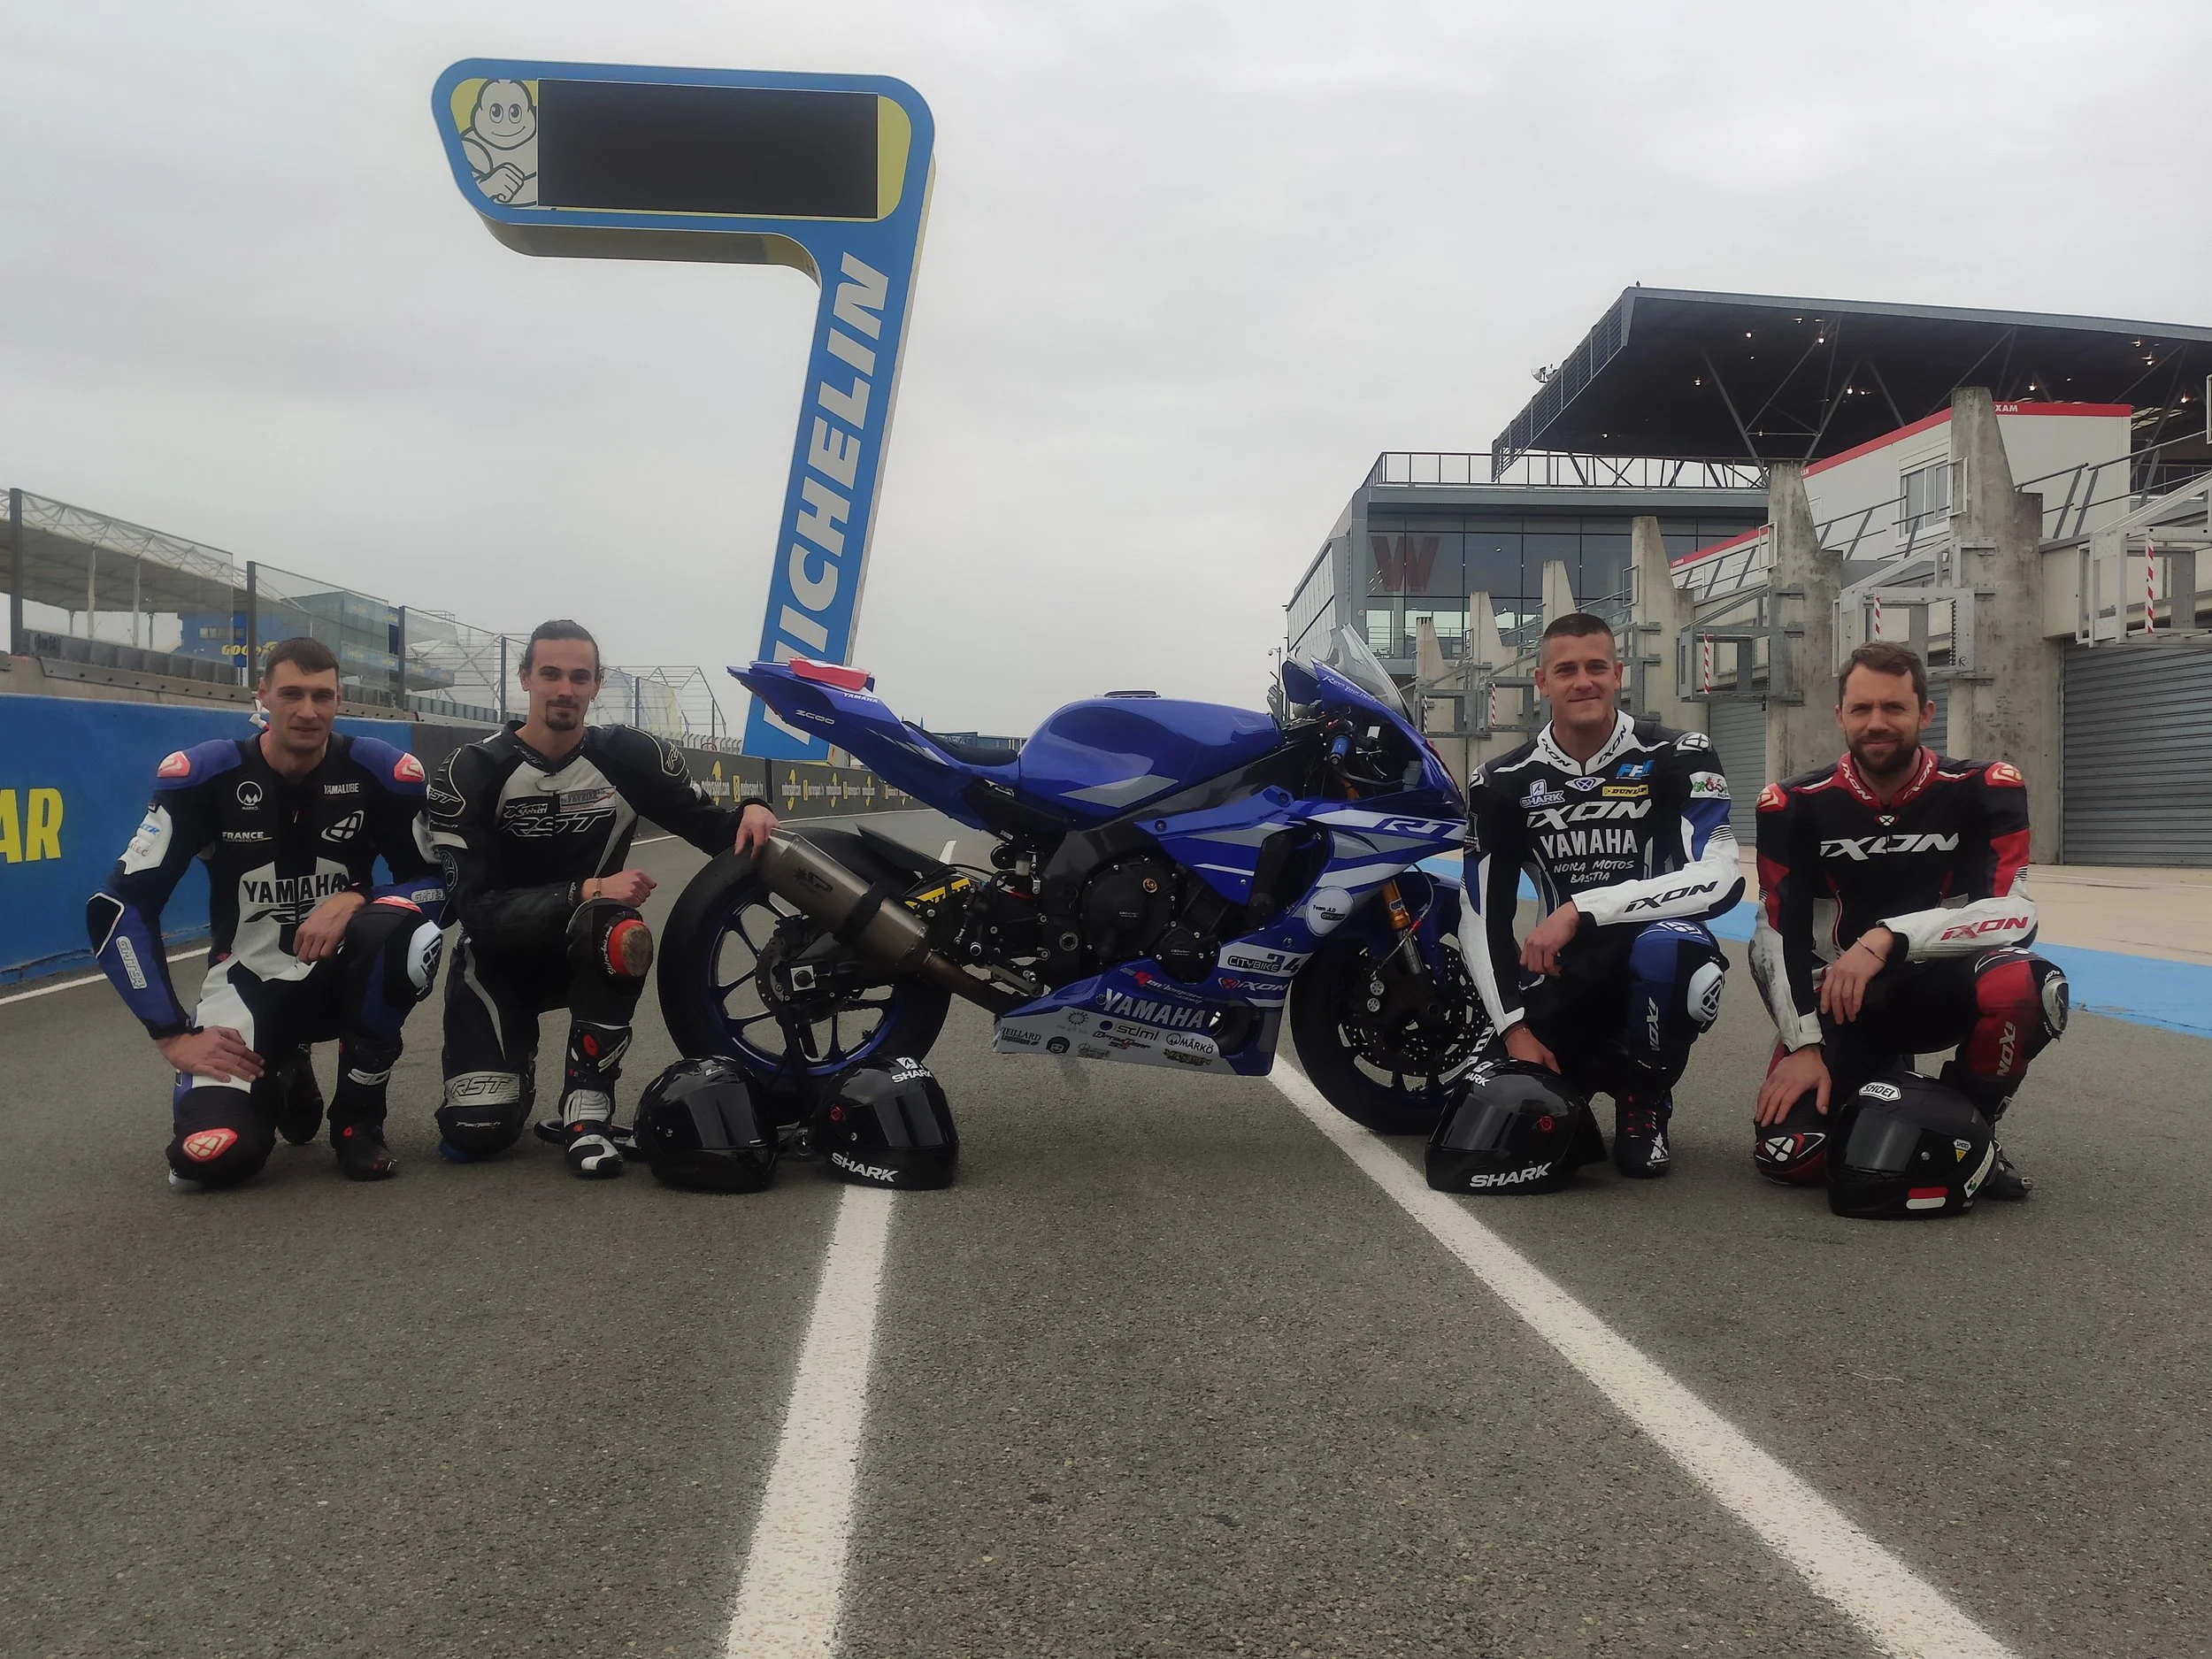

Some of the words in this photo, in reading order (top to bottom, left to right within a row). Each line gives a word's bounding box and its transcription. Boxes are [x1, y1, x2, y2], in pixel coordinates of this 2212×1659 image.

[843, 693, 879, 703] YAMAHA
[324, 783, 359, 795] YAMALUBE
[1521, 792, 1563, 807] SHARK
[1526, 799, 1653, 830] IXON
[1379, 818, 1458, 839] R1
[1540, 829, 1638, 859] YAMAHA
[1819, 833, 1959, 861] IXON
[1592, 860, 1634, 870] MOTOS
[242, 872, 347, 903] YAMAHA
[1570, 872, 1610, 883] BASTIA
[1624, 880, 1718, 913] IXON
[1940, 917, 2028, 941] IXON
[1228, 956, 1281, 972] CITYBIKE
[1103, 987, 1206, 1028] YAMAHA
[1996, 1021, 2017, 1077] IXON
[891, 1065, 933, 1083] SHARK
[451, 1077, 511, 1097] RST
[1864, 1084, 1895, 1098] SHOEI
[830, 1153, 899, 1182] SHARK
[1470, 1163, 1552, 1187] SHARK
